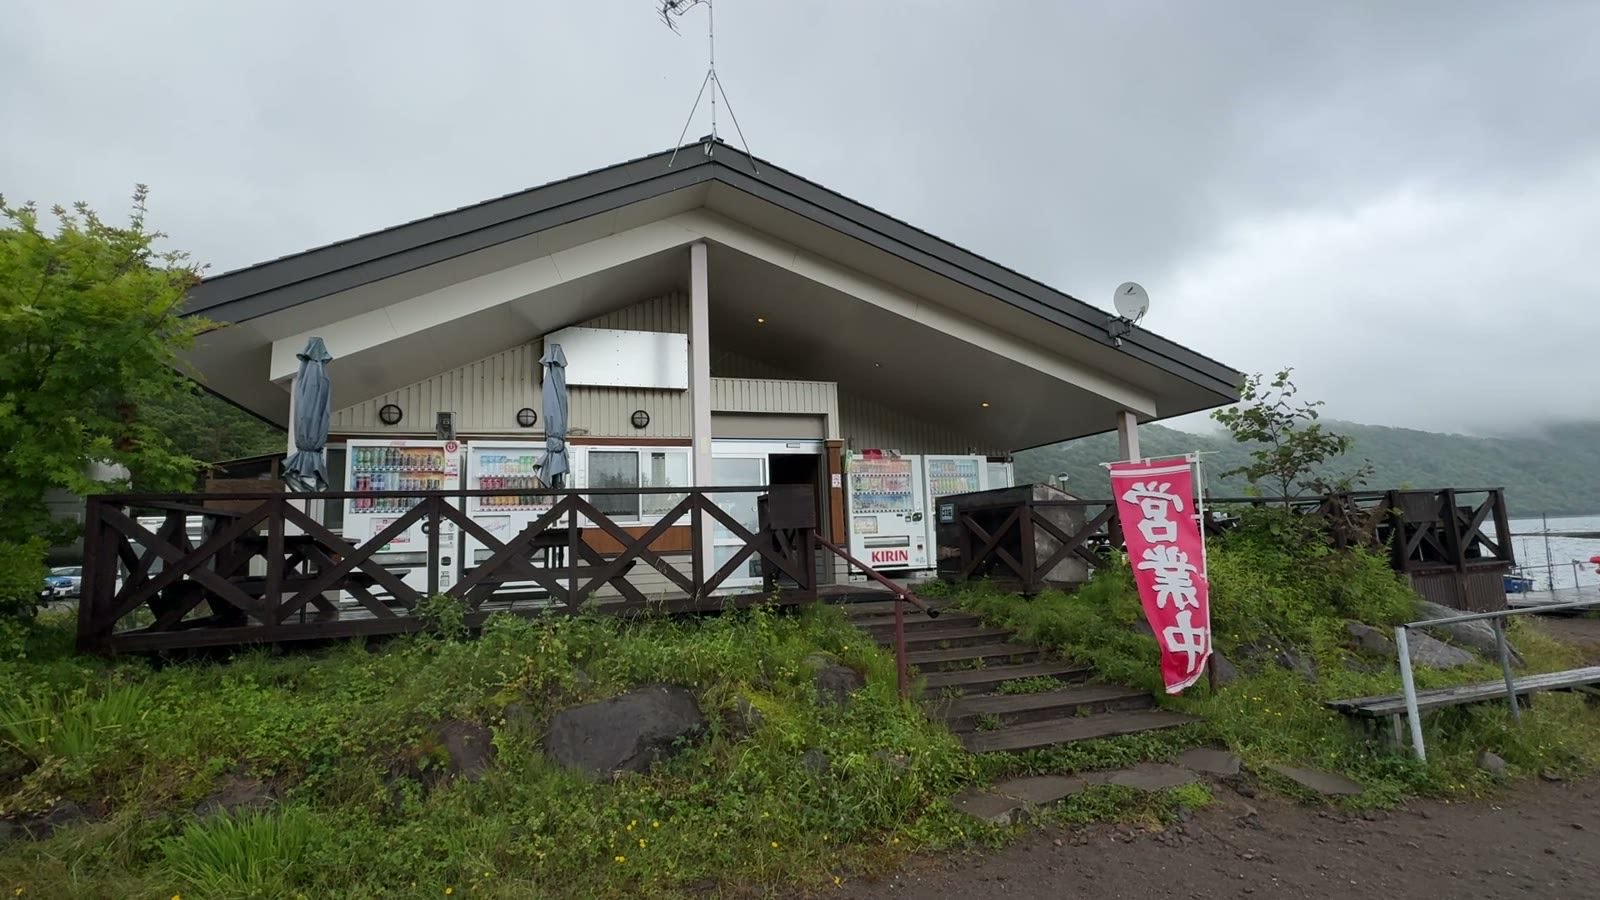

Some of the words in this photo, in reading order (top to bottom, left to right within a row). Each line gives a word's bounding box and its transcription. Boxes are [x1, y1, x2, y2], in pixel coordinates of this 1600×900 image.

[872, 550, 909, 562] KIRIN
[1122, 480, 1206, 673] 営業中
